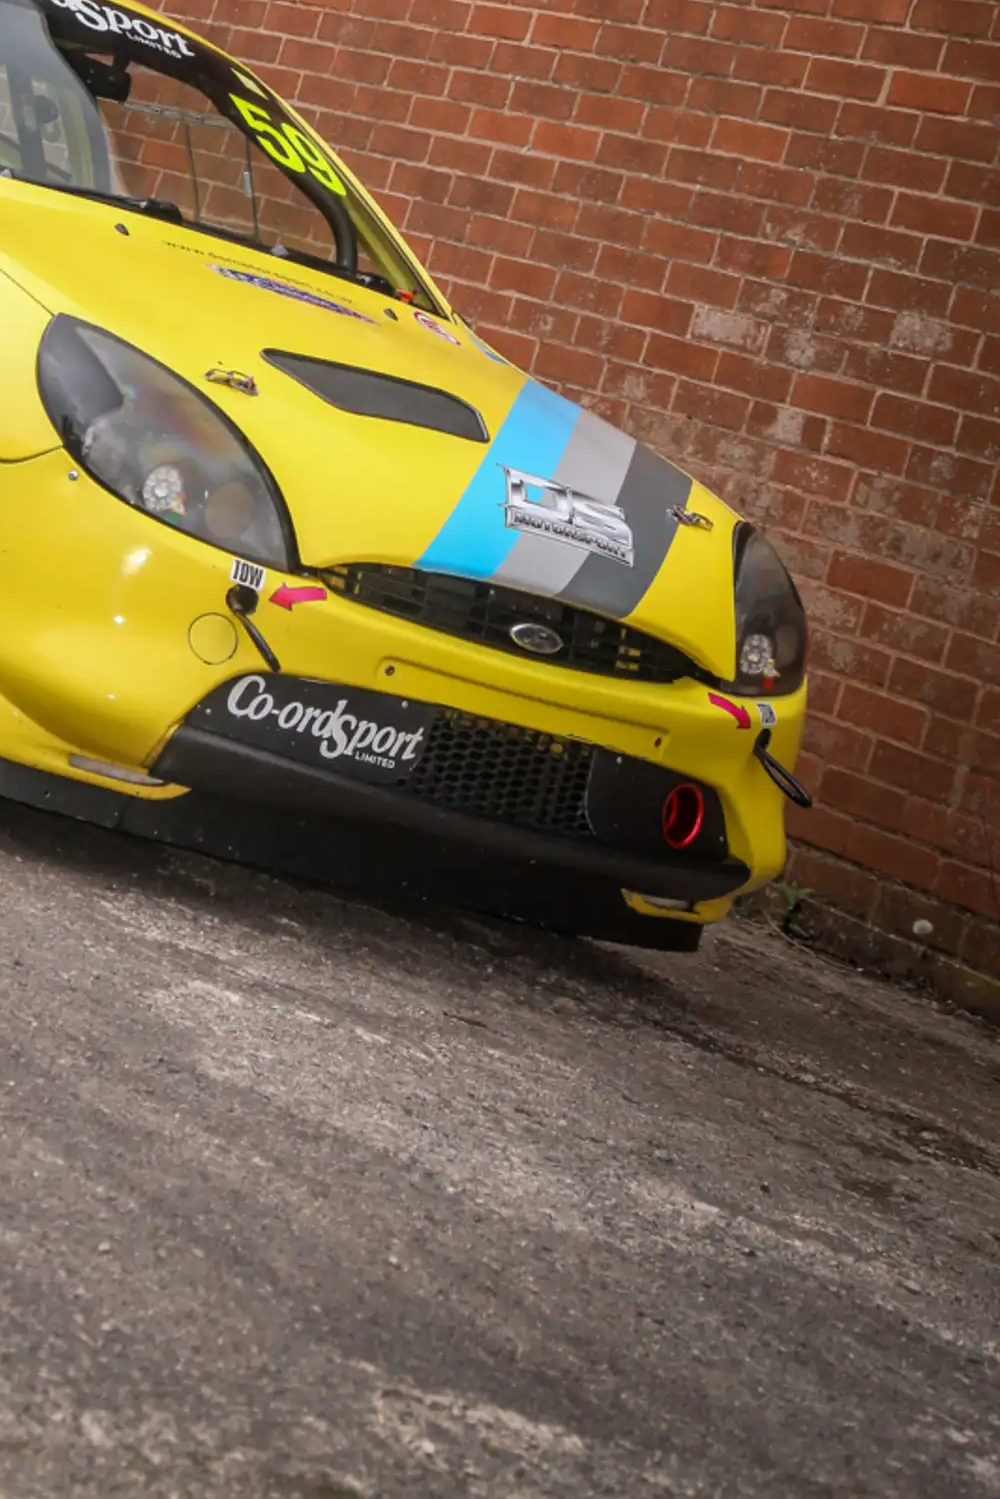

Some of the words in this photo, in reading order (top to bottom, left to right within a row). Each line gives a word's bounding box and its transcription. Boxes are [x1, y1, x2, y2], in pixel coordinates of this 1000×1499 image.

[126, 30, 182, 59] LIMITED
[228, 92, 347, 197] 59
[233, 559, 264, 589] TOW
[227, 675, 425, 761] Co-ordSport
[354, 750, 396, 769] LIMITED
